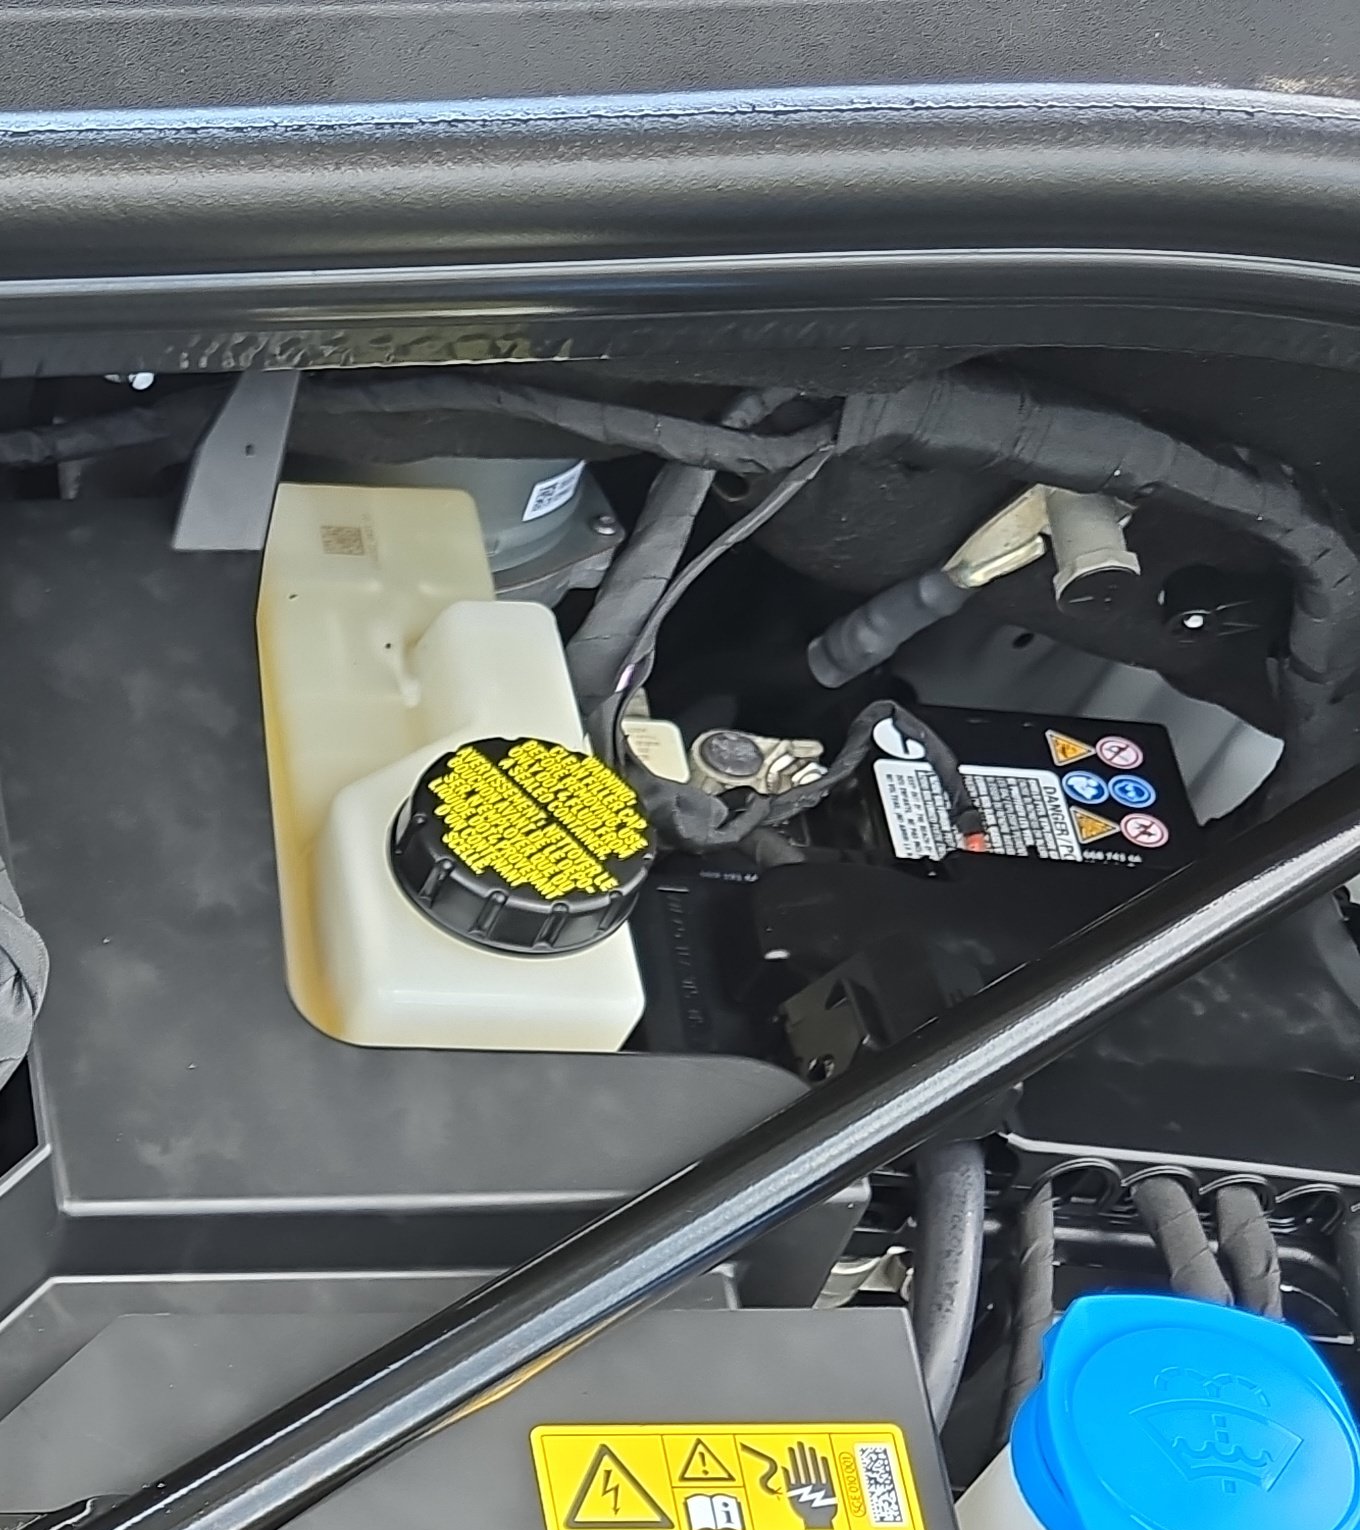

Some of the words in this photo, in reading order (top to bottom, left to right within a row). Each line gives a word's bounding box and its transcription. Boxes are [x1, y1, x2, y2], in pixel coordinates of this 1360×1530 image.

[447, 758, 501, 805] BOUCHON
[494, 801, 532, 834] AVANT
[508, 766, 552, 804] SEALED
[508, 747, 541, 775] ONLY
[564, 798, 600, 829] FLUID
[594, 827, 631, 858] FROM
[522, 740, 566, 778] BEFORE
[617, 828, 645, 851] USE
[549, 746, 586, 778] CLEAN
[581, 776, 623, 812] FILLER
[428, 780, 473, 819] LIQUIDE
[494, 842, 561, 900] PROVENANT
[459, 829, 525, 887] CONTENANT
[542, 825, 600, 875] NETTOYER
